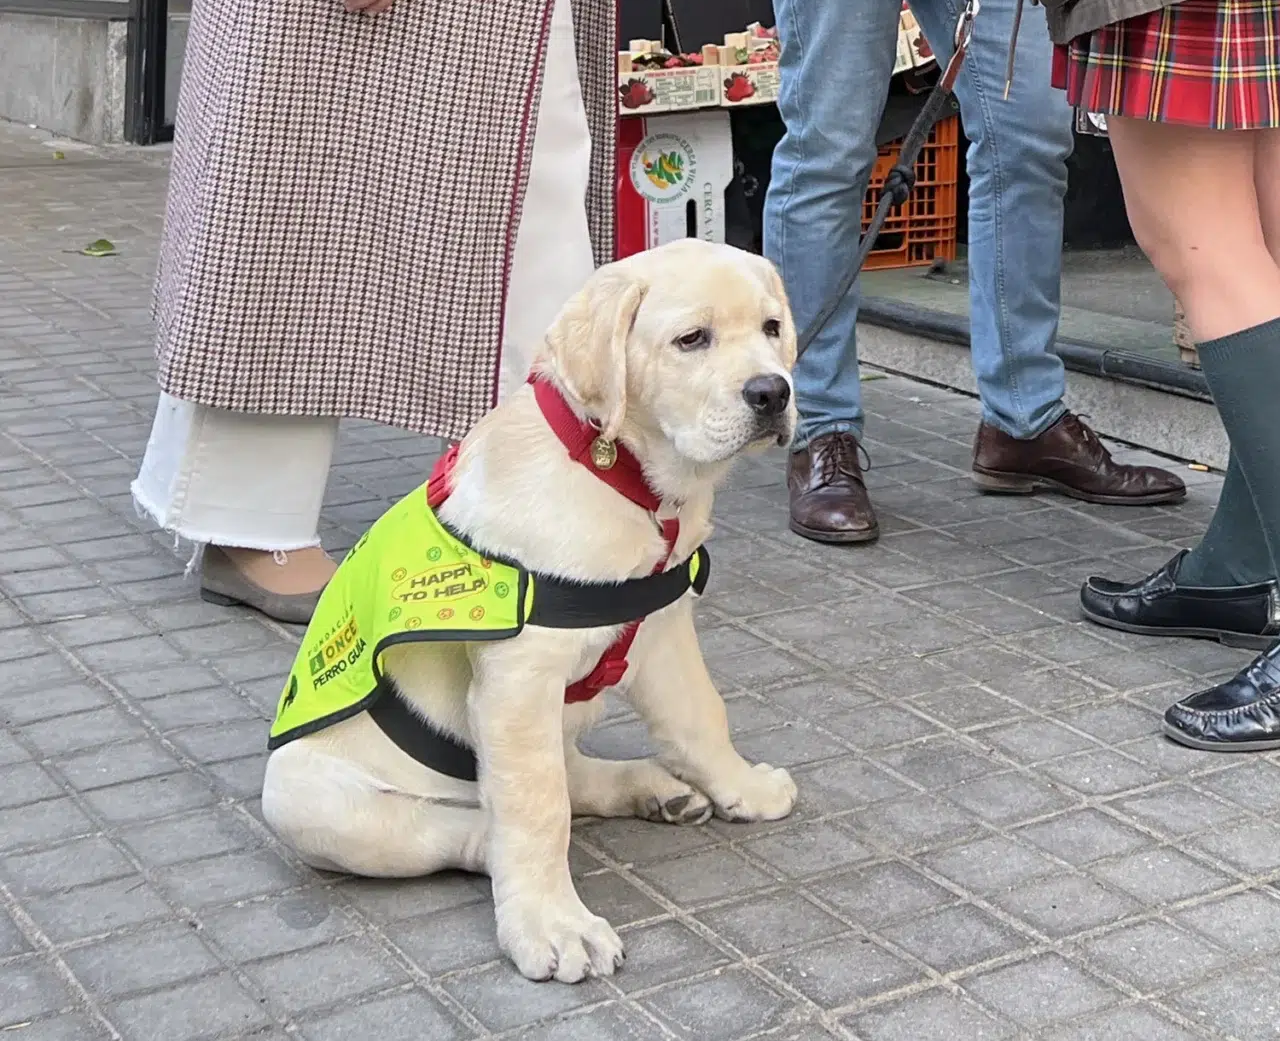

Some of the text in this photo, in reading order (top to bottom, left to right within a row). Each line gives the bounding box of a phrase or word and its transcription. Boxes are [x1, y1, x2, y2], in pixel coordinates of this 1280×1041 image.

[703, 182, 713, 224] CERCA
[410, 563, 472, 588] HAPPY
[399, 591, 427, 603] TO
[325, 619, 357, 659] ONCE
[313, 659, 347, 692] PERRO
